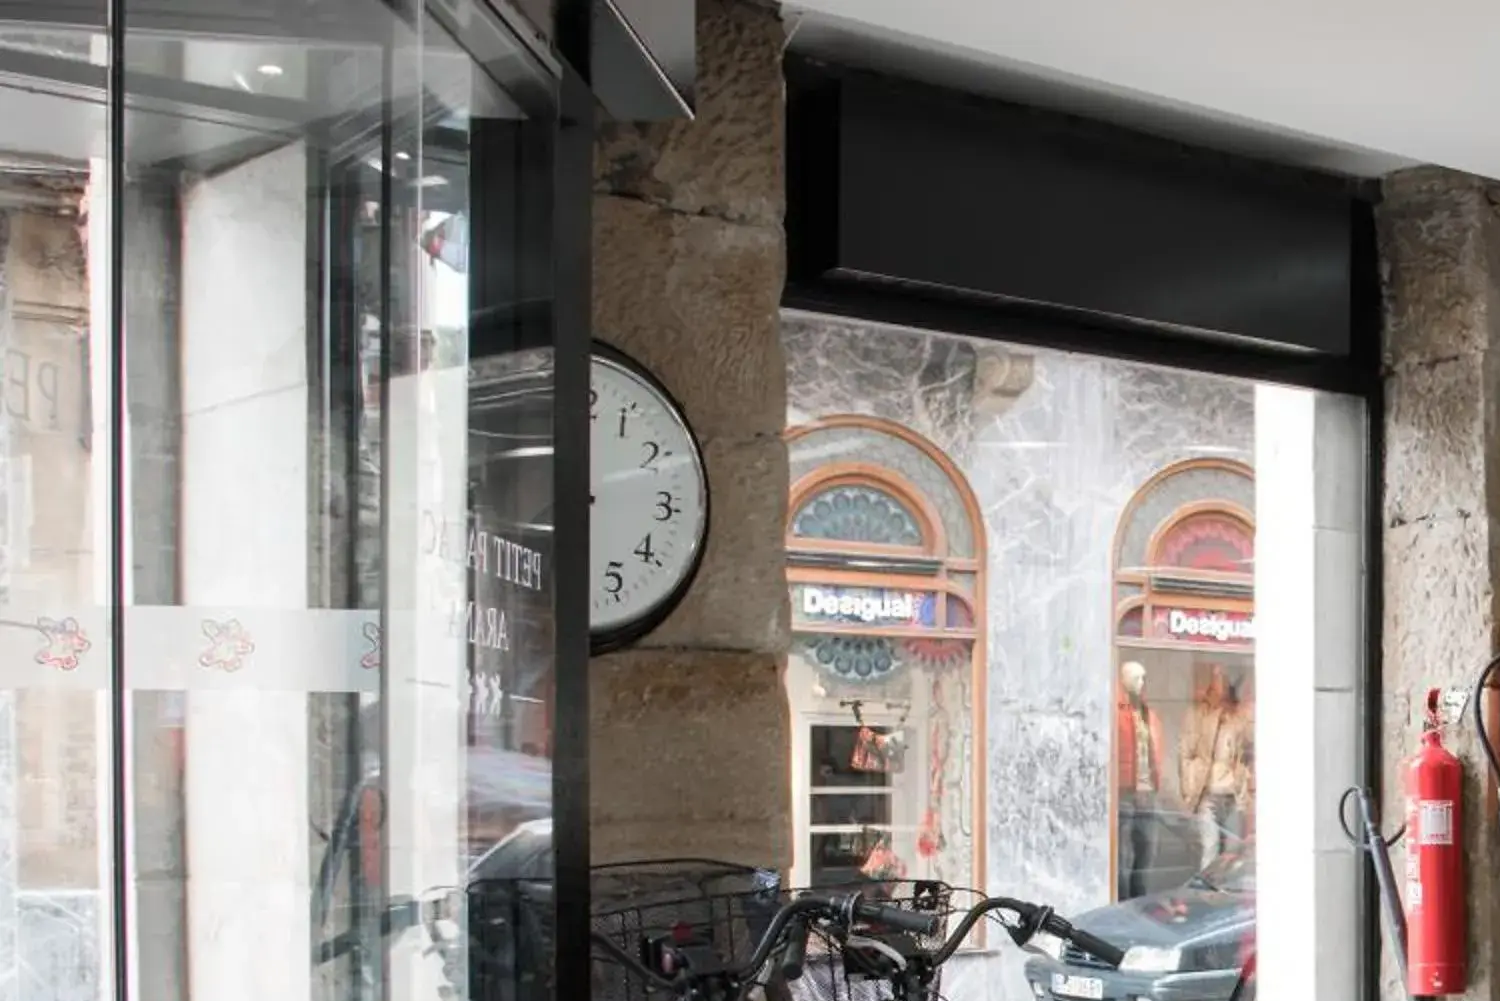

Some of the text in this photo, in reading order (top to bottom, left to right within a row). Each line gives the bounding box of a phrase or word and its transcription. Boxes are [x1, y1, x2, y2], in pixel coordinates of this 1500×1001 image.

[639, 441, 660, 474] 2
[653, 491, 673, 521] 3
[633, 533, 654, 563] 4
[605, 561, 624, 594] 5
[803, 587, 913, 622] Desigual
